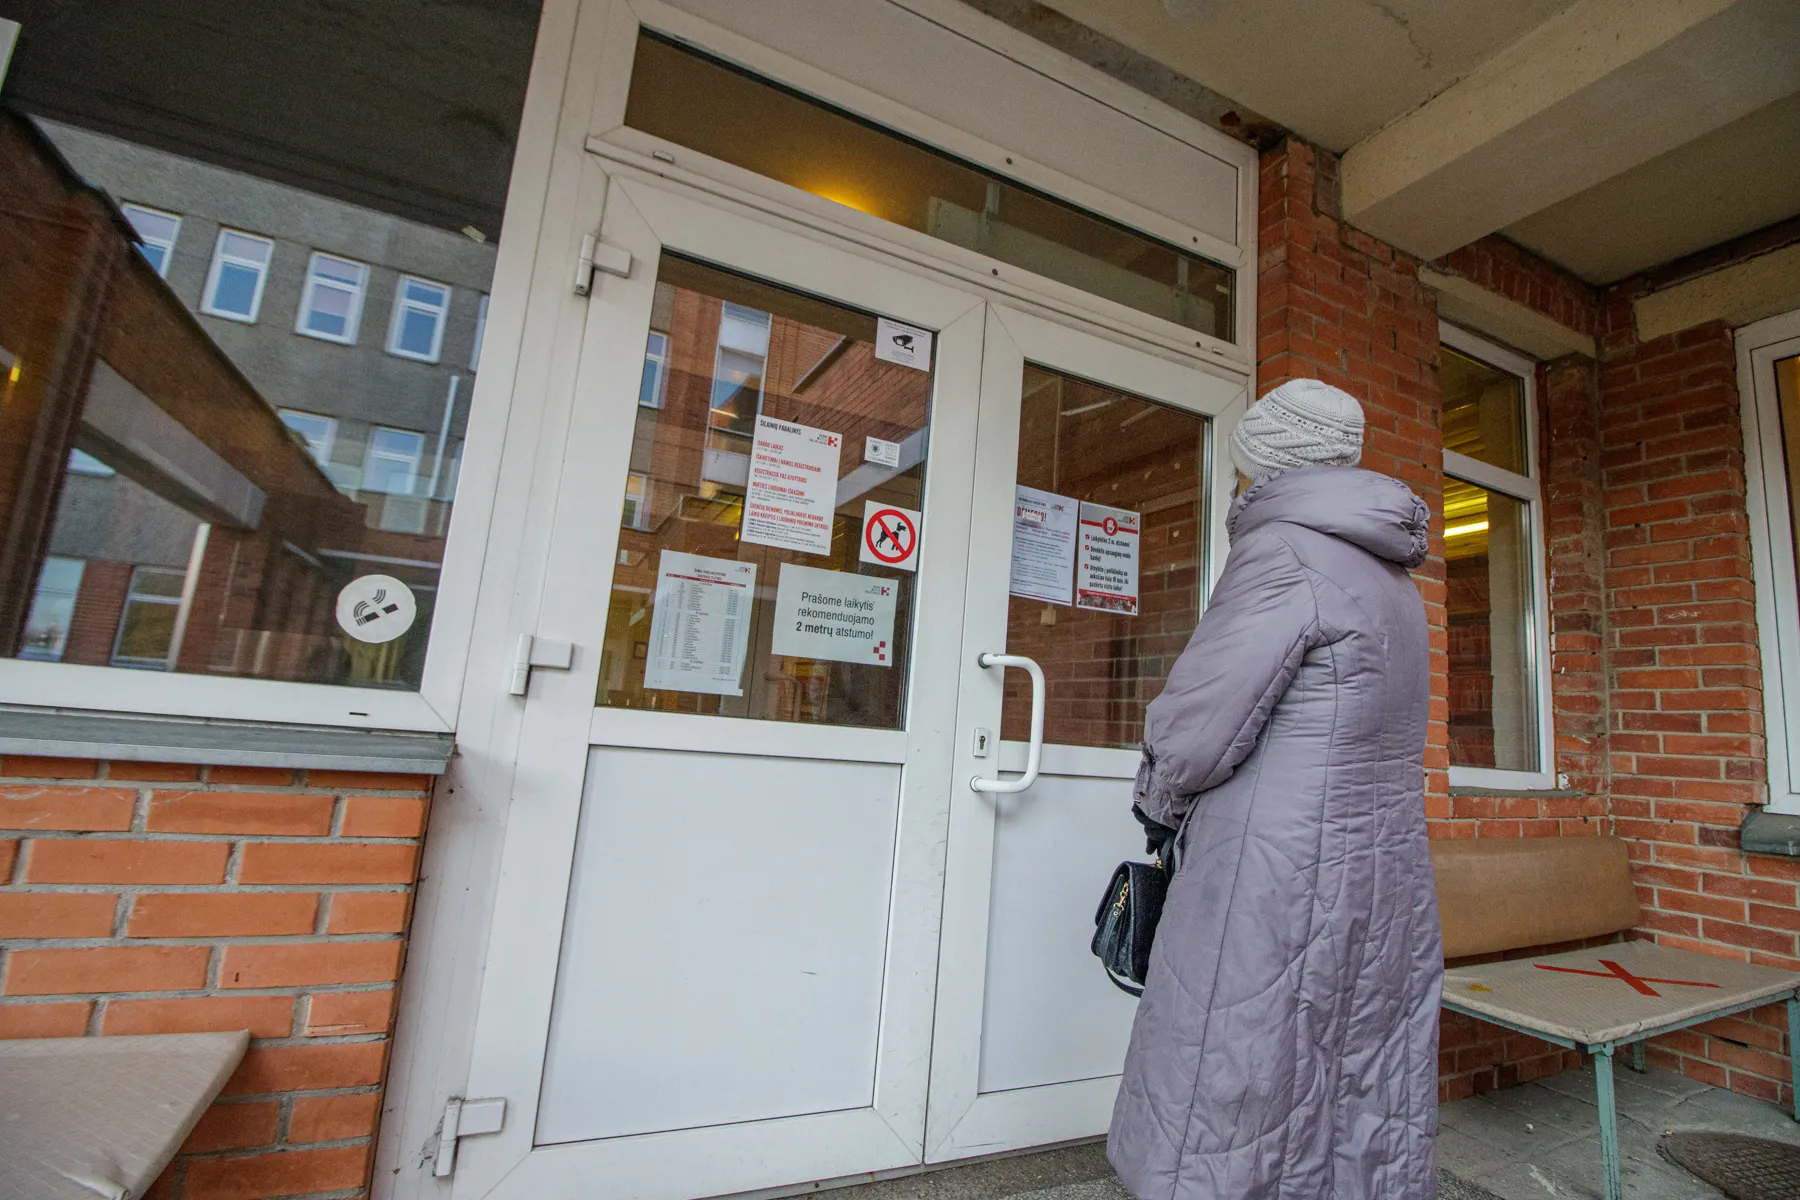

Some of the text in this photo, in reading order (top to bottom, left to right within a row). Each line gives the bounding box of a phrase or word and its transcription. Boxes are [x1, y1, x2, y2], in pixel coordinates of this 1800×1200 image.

[779, 425, 801, 435] PADALINYS
[802, 592, 874, 612] Prašome laikytis
[798, 608, 874, 626] rekomenduojamo
[796, 622, 874, 640] 2 metrų atstumo!
